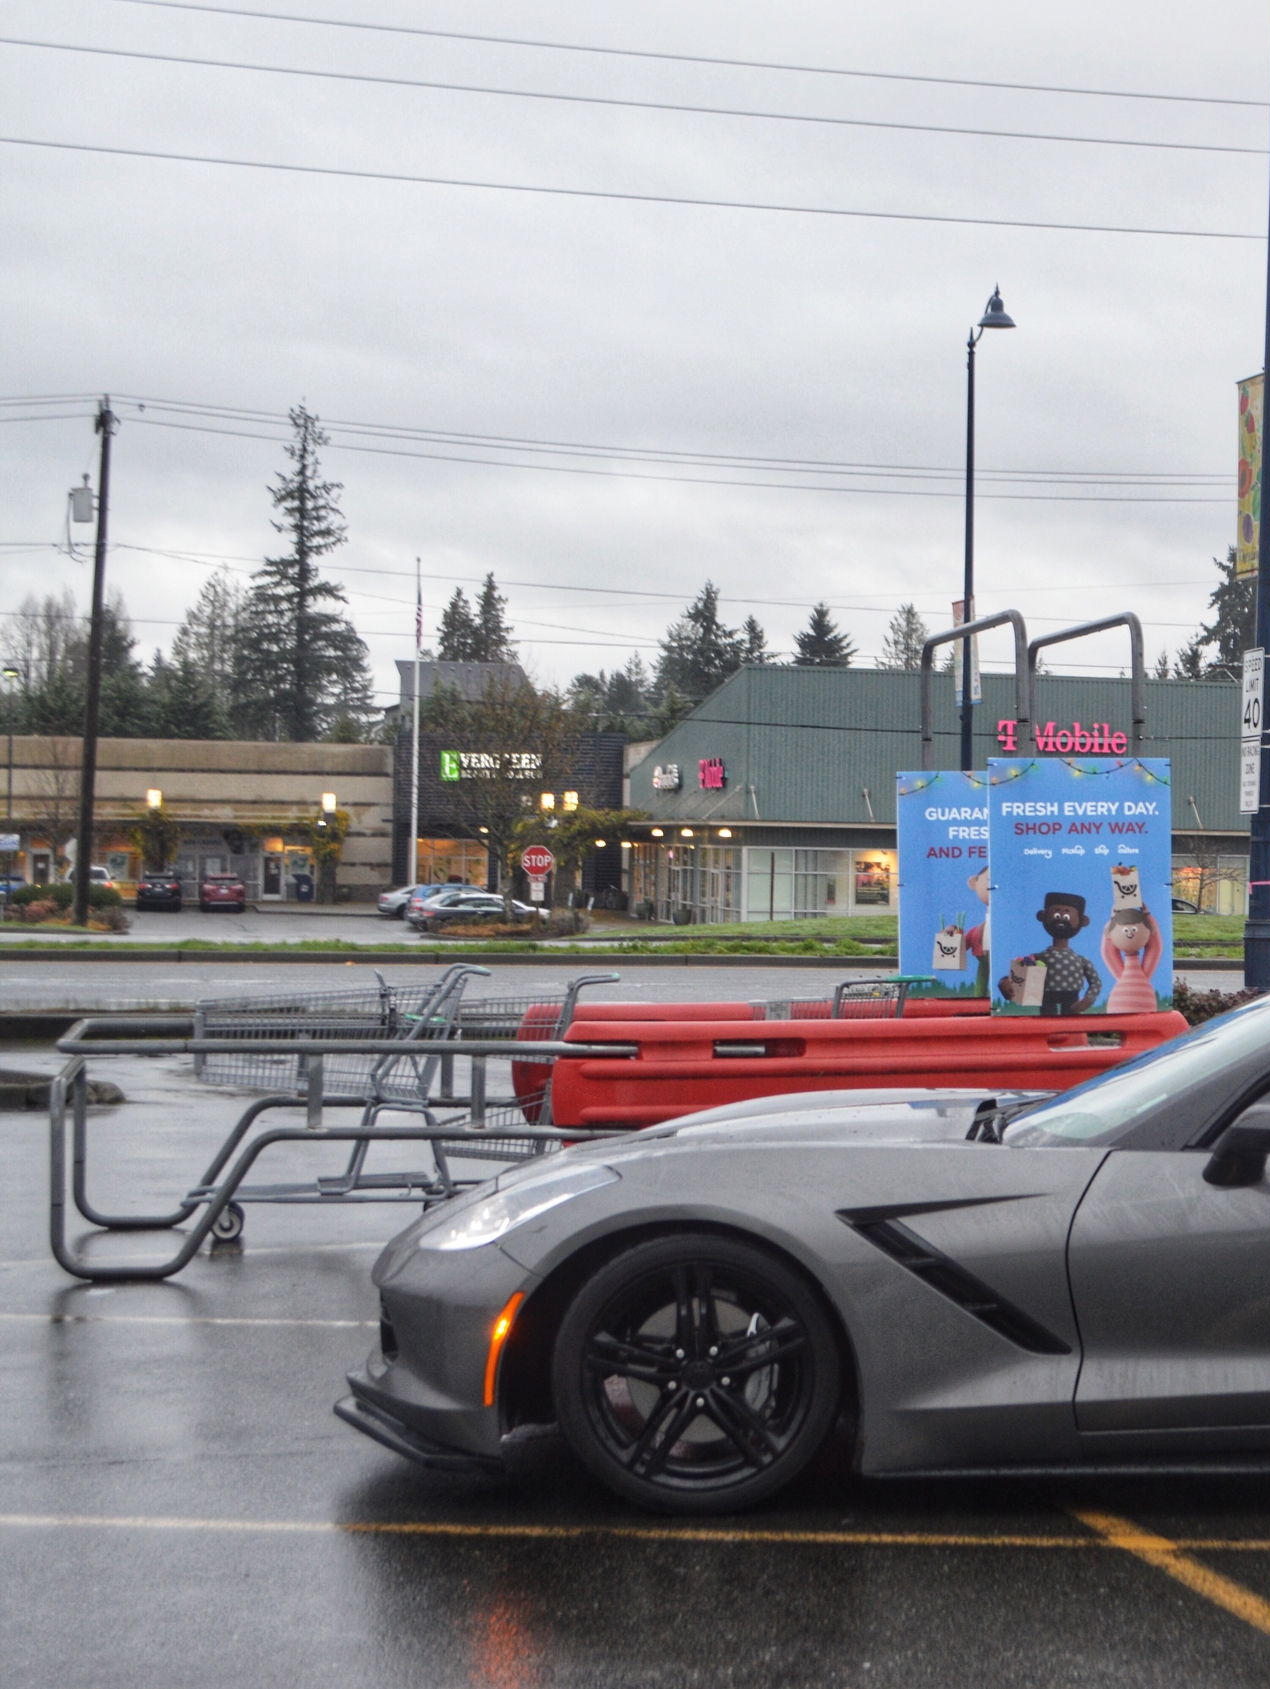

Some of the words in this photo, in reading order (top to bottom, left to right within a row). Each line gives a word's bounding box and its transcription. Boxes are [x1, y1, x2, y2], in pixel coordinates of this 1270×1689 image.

[1245, 657, 1262, 674] SPEED
[1245, 677, 1259, 693] LIMIT
[1243, 697, 1260, 730] 40
[1001, 802, 1059, 817] FRESH
[1063, 802, 1120, 816] EVERY
[1123, 801, 1160, 816] DAY.
[948, 826, 989, 840] FRES
[1014, 821, 1063, 836] SHOP
[1067, 821, 1103, 835] ANY
[1107, 821, 1149, 835] WAY.
[926, 846, 963, 859] AND
[967, 846, 988, 859] FE
[1023, 847, 1053, 859] Delivery
[523, 854, 552, 867] STOP
